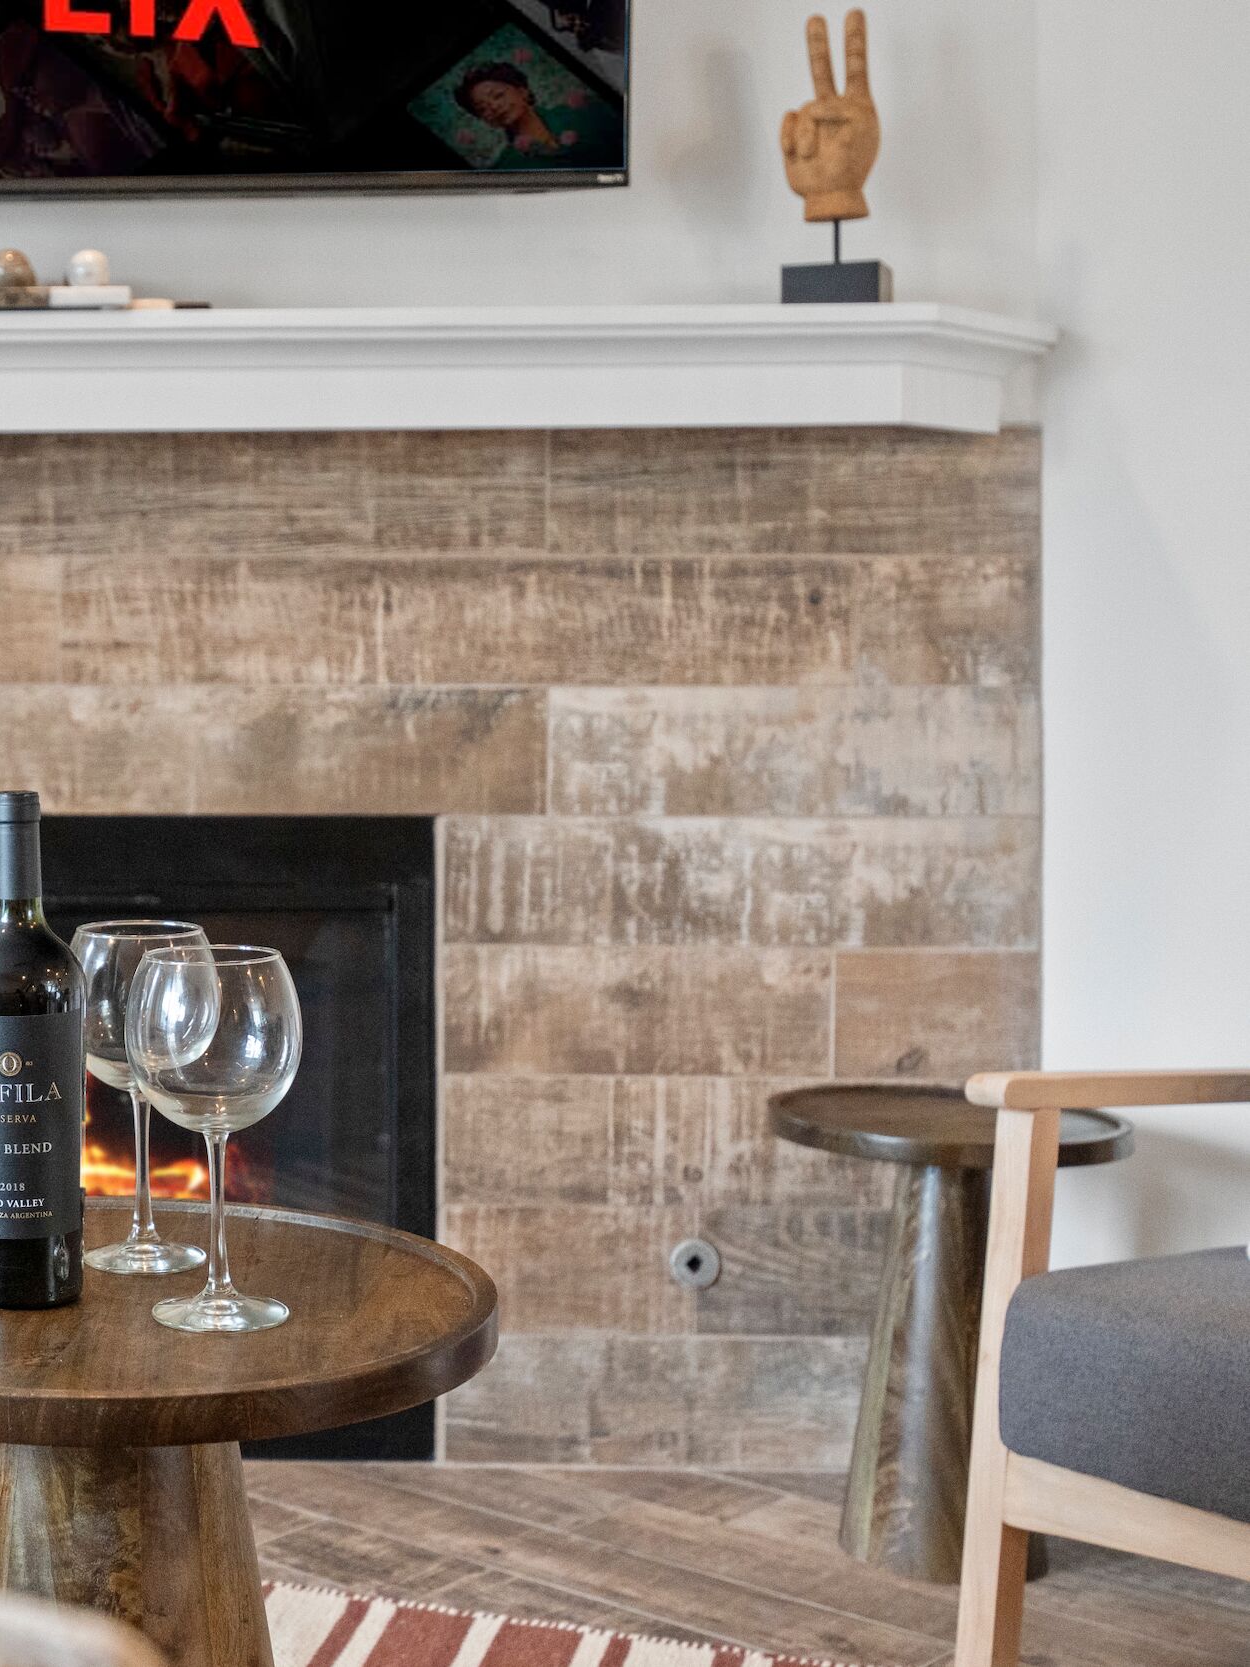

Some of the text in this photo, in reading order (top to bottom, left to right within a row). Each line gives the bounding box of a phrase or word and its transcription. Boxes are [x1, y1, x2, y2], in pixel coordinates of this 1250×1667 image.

[4, 1143, 52, 1155] BLEND
[0, 1182, 25, 1192] 2018
[6, 1198, 45, 1208] VALLEY
[10, 1210, 53, 1220] ARGENTINA
